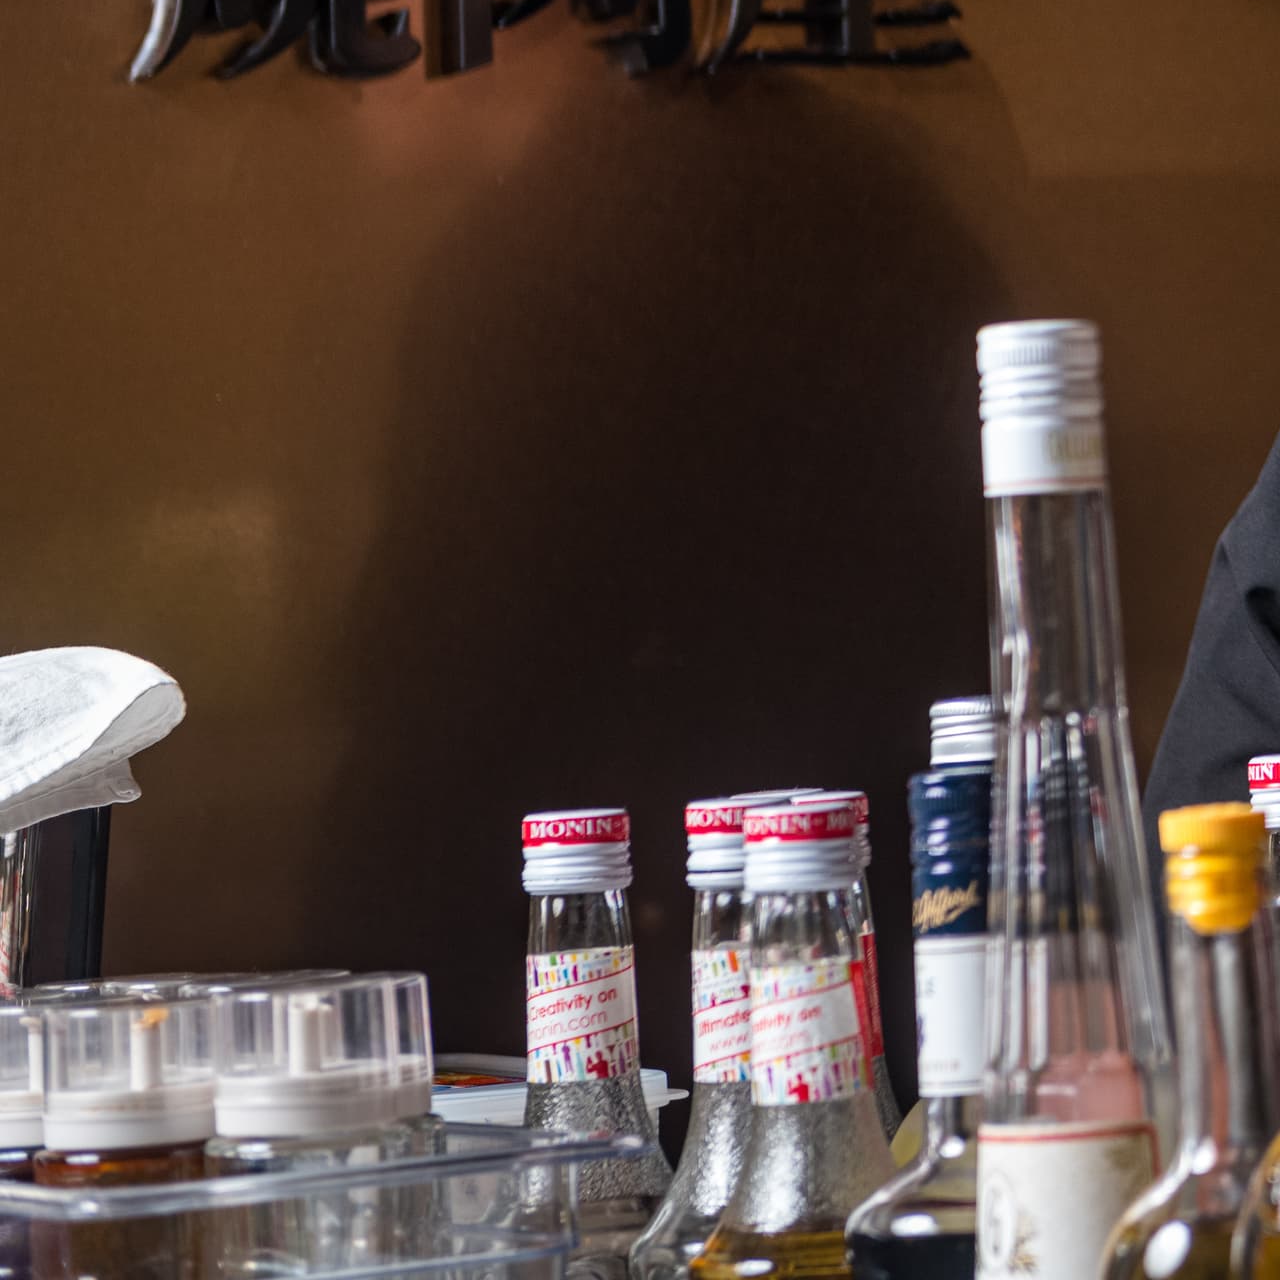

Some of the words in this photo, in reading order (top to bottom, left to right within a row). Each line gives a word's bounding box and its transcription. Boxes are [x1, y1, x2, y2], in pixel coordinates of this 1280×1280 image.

[1248, 763, 1274, 782] NIN
[686, 807, 743, 828] MONI
[745, 815, 811, 836] ONIN
[530, 818, 612, 839] MONIN
[528, 993, 593, 1021] Creativity
[598, 988, 618, 1004] on
